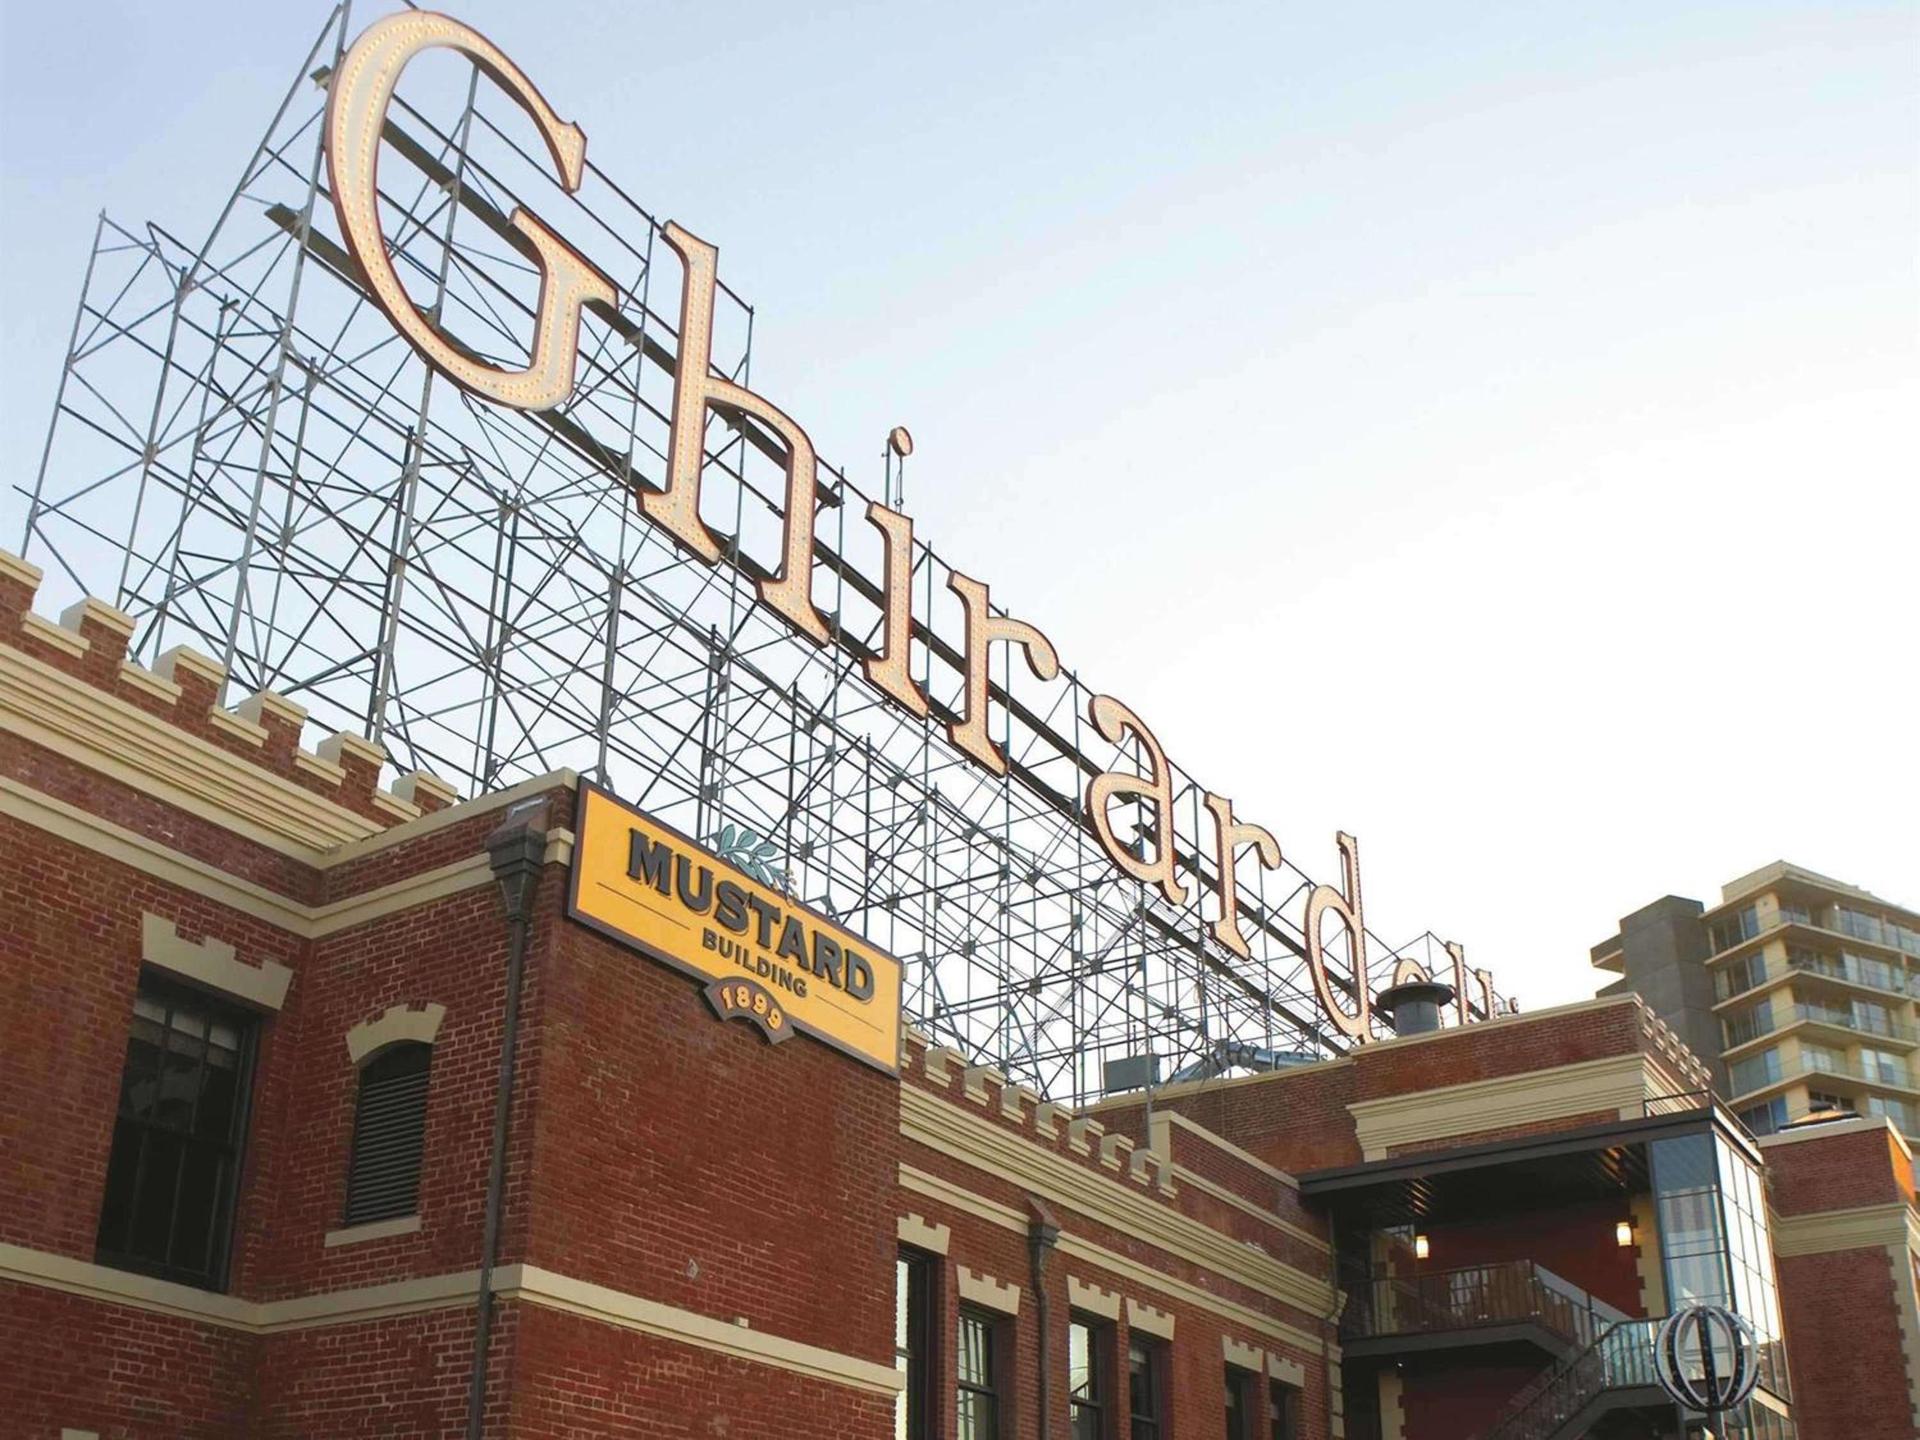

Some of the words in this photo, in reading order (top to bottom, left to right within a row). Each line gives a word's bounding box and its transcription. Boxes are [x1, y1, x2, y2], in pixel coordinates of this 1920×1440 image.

[323, 10, 1519, 1046] Ghirardl
[626, 827, 876, 1004] MUSTARD
[702, 927, 808, 999] BUILDING
[722, 986, 783, 1031] 1899
